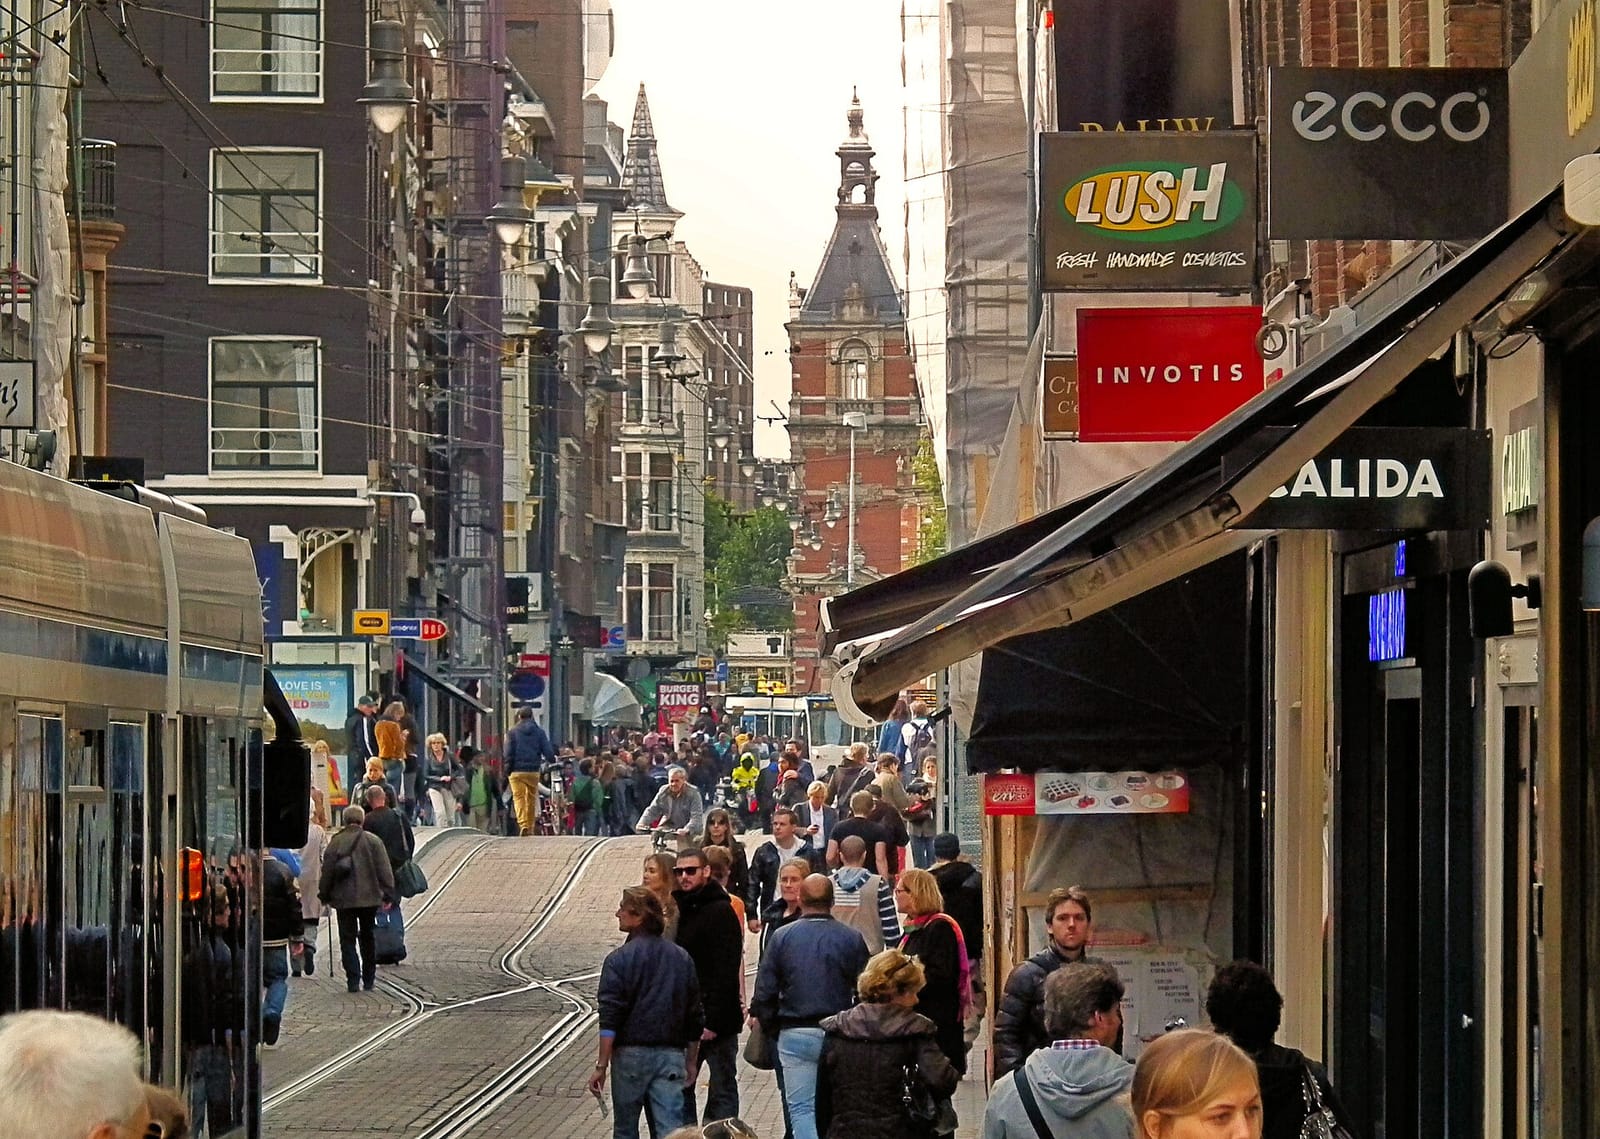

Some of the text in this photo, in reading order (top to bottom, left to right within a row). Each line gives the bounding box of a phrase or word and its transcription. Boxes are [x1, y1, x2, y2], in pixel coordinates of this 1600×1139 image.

[1292, 91, 1490, 142] ecco
[1076, 162, 1228, 224] LUSH
[1056, 251, 1247, 269] FRESH HANDMADE COSMETICS
[1097, 364, 1243, 384] INVOTIS
[1049, 376, 1078, 394] Cr
[1269, 458, 1444, 498] ALIDA
[280, 681, 322, 691] LOVE IS
[659, 685, 699, 693] BURGER
[659, 693, 699, 706] KING
